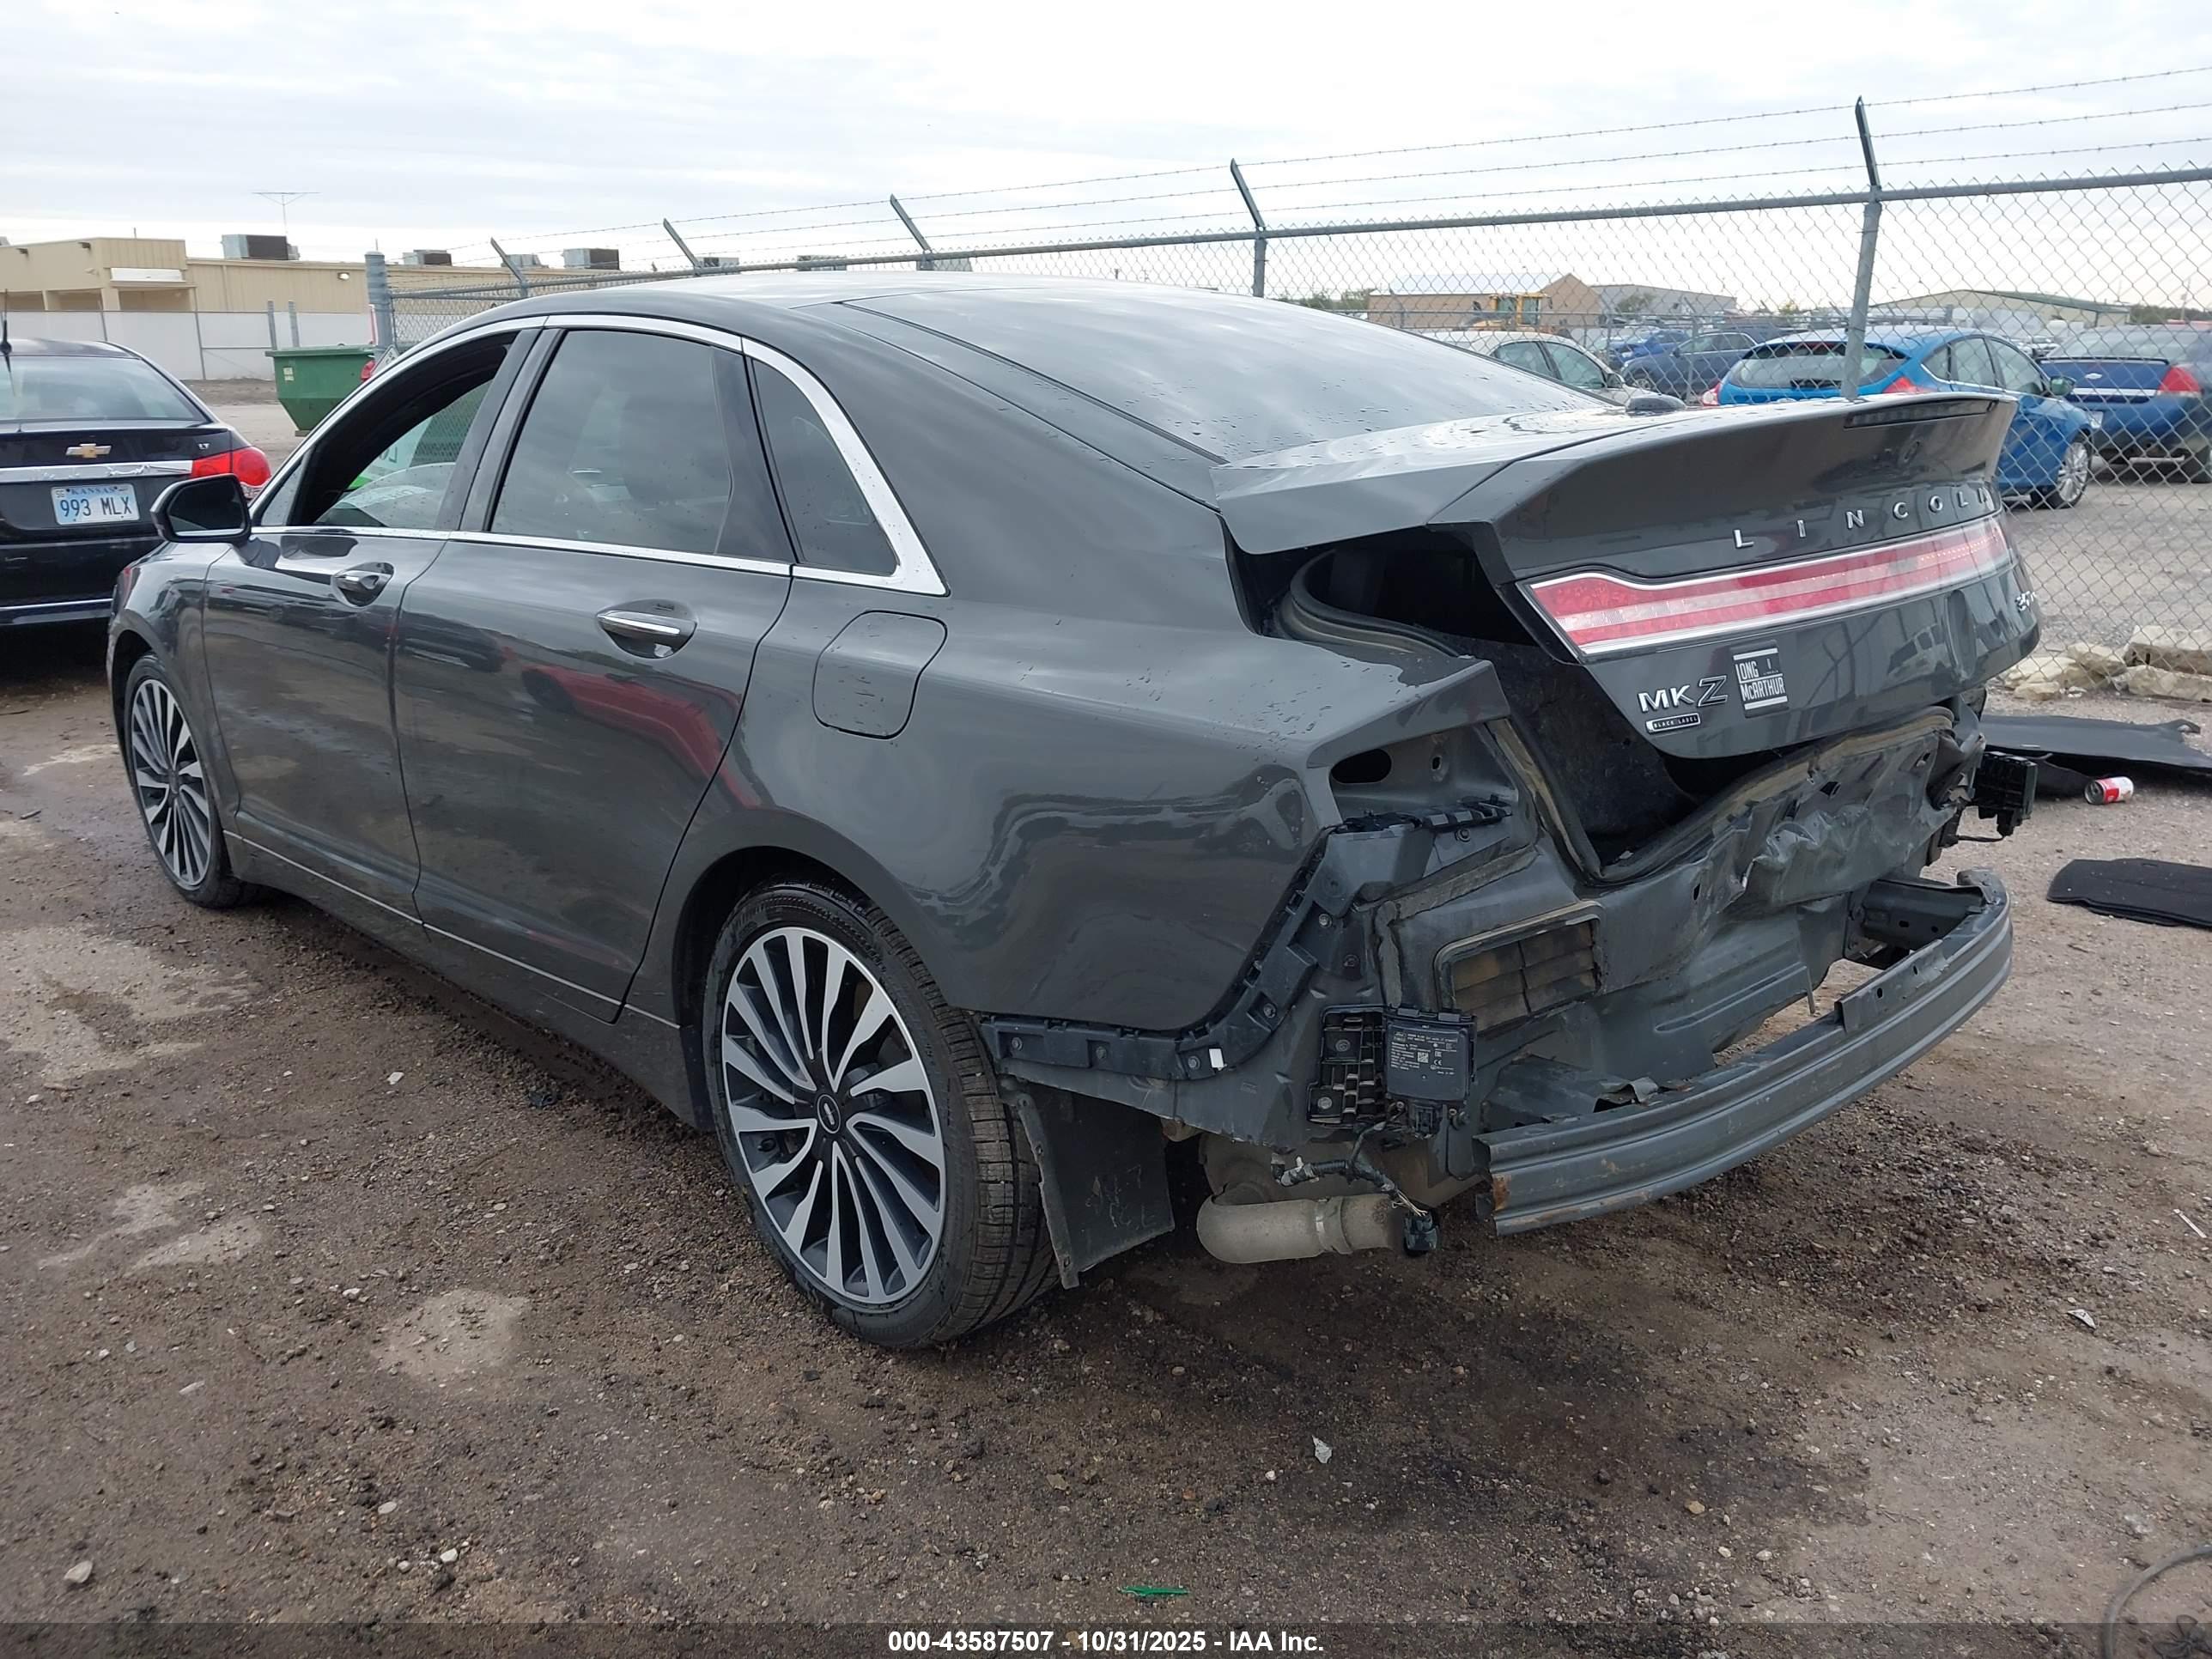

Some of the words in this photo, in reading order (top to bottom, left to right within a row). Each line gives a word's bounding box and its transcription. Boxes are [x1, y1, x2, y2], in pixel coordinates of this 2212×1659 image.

[59, 499, 91, 517] 993
[100, 496, 132, 515] MLX
[1735, 660, 1759, 684] LONG
[1637, 674, 1729, 714] MKZ
[1740, 676, 1786, 702] McARTHUR
[1653, 720, 1675, 729] BLACK
[1678, 715, 1698, 725] LABEL
